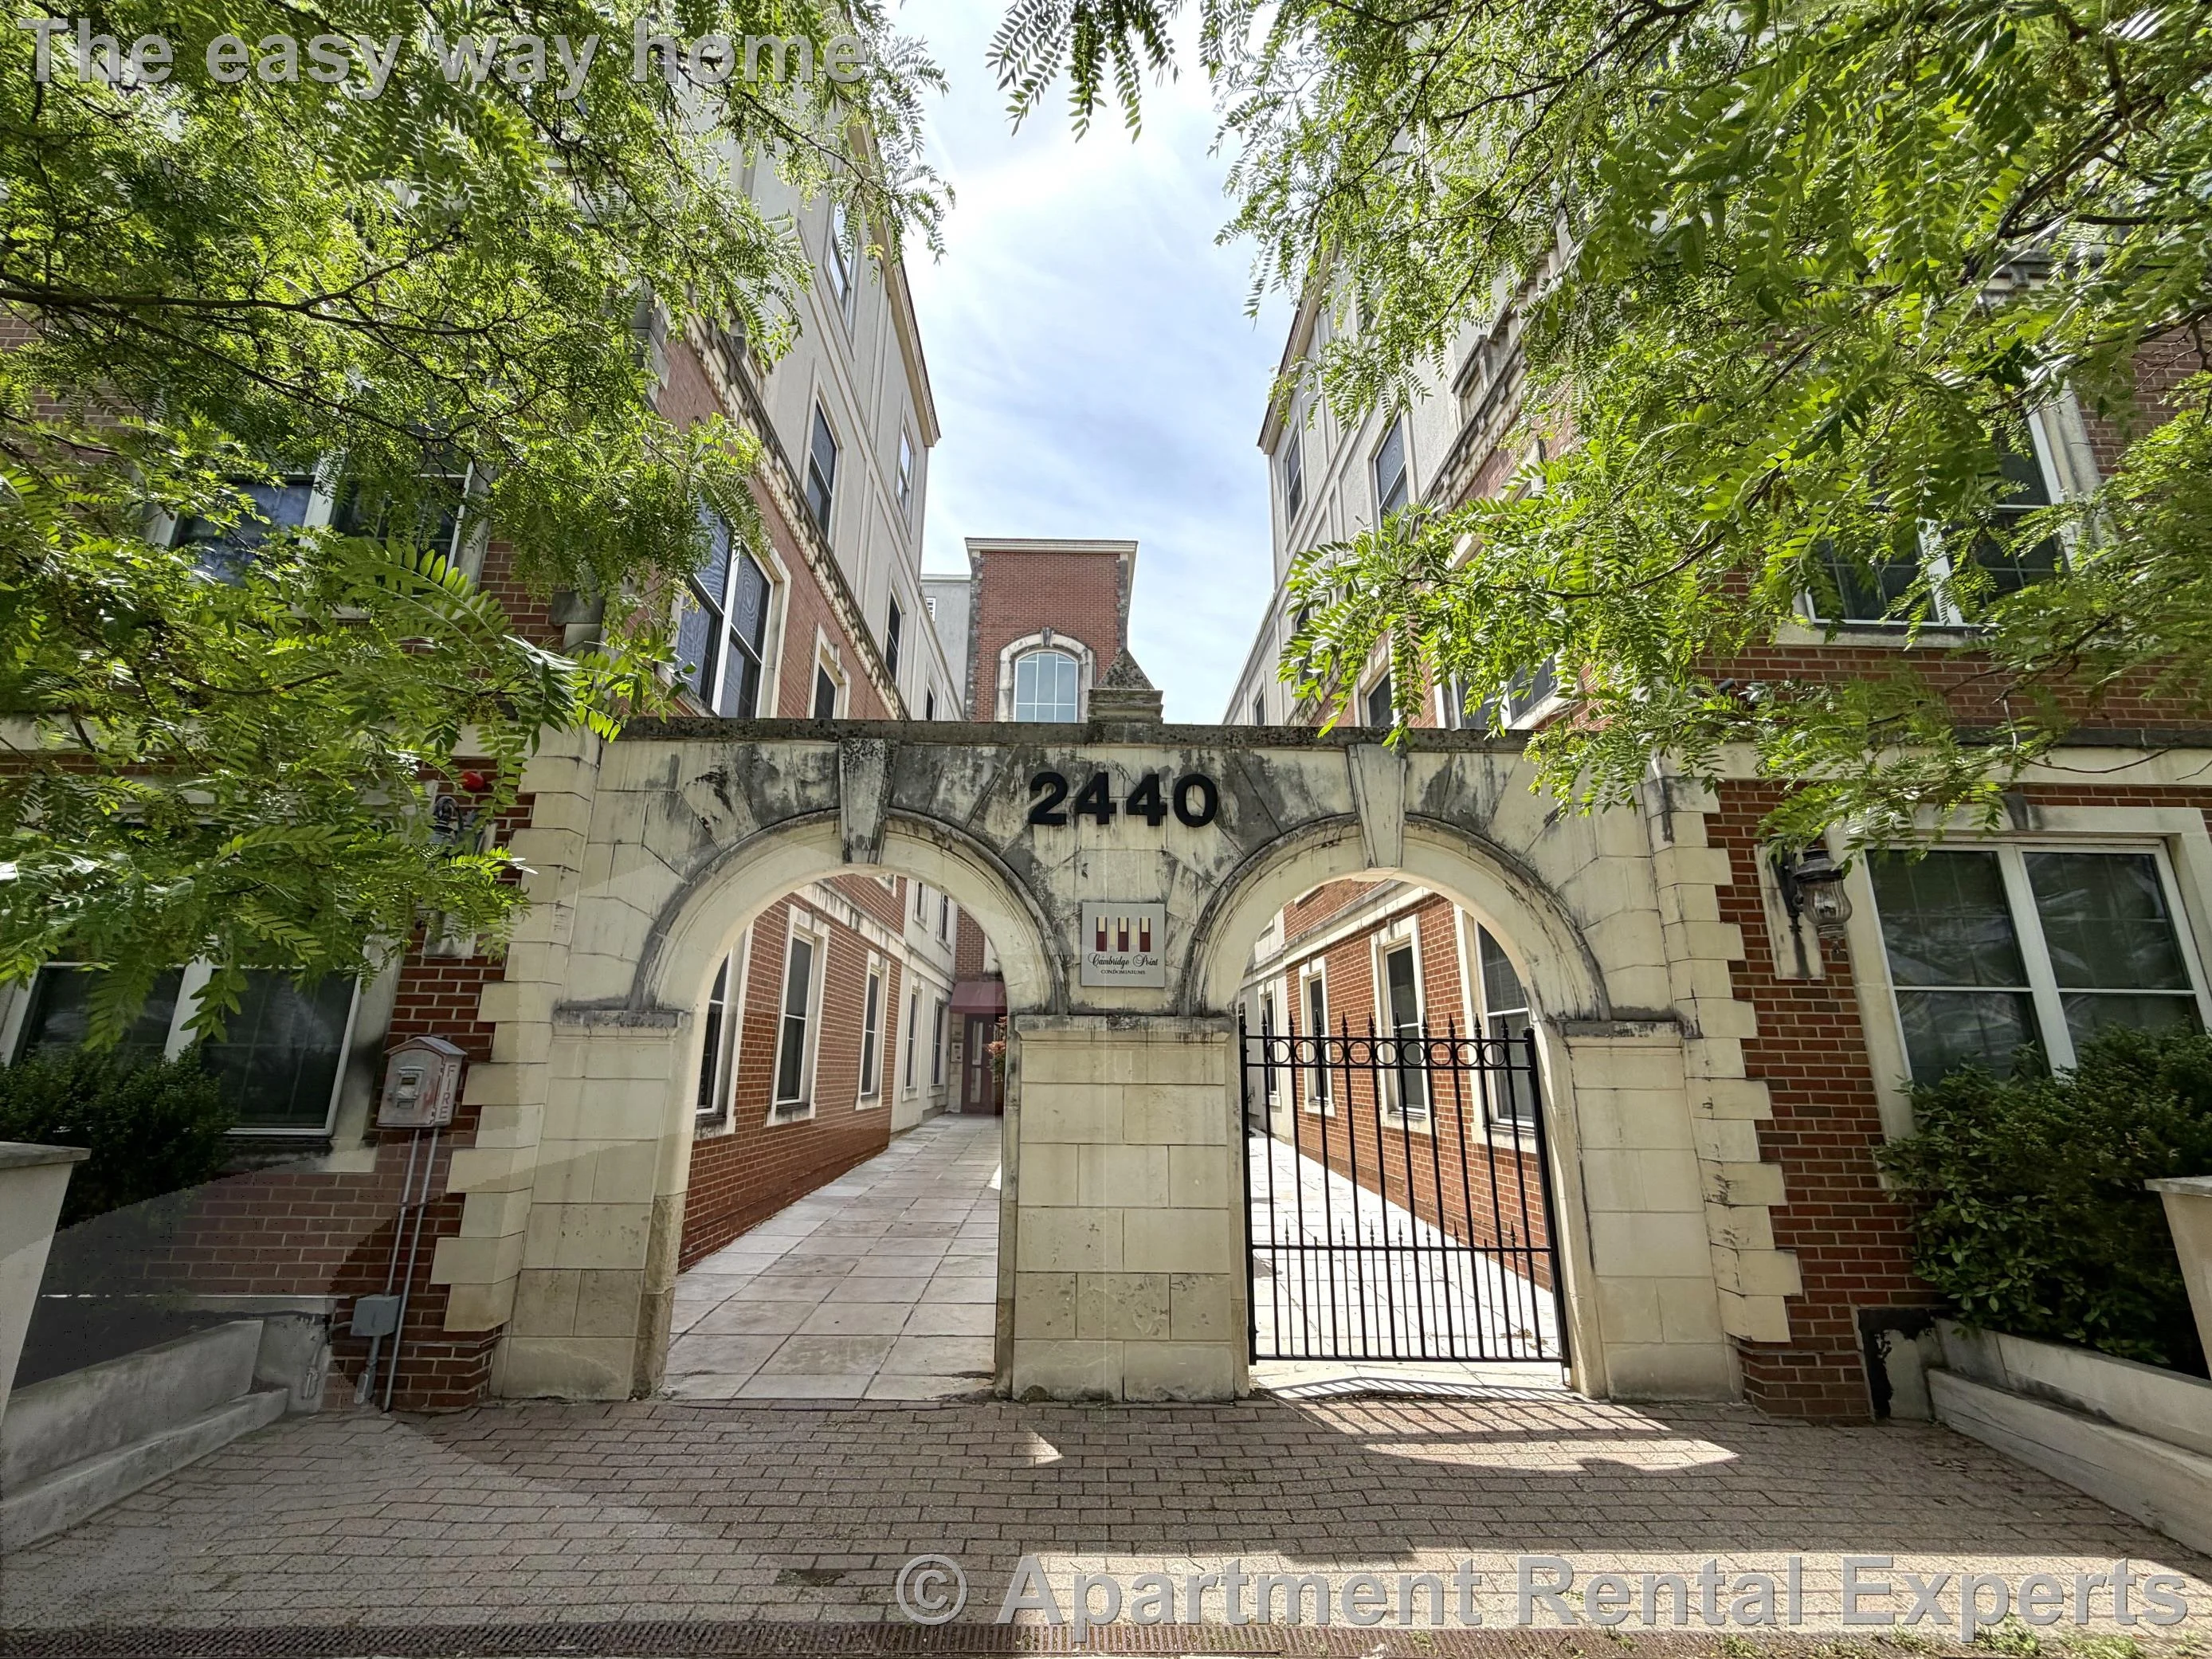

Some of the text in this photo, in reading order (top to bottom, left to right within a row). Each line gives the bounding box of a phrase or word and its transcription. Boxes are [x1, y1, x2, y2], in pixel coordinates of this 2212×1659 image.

[1028, 771, 1218, 828] 2440
[1088, 952, 1159, 969] Cambridge Point
[439, 1065, 457, 1119] FIRE
